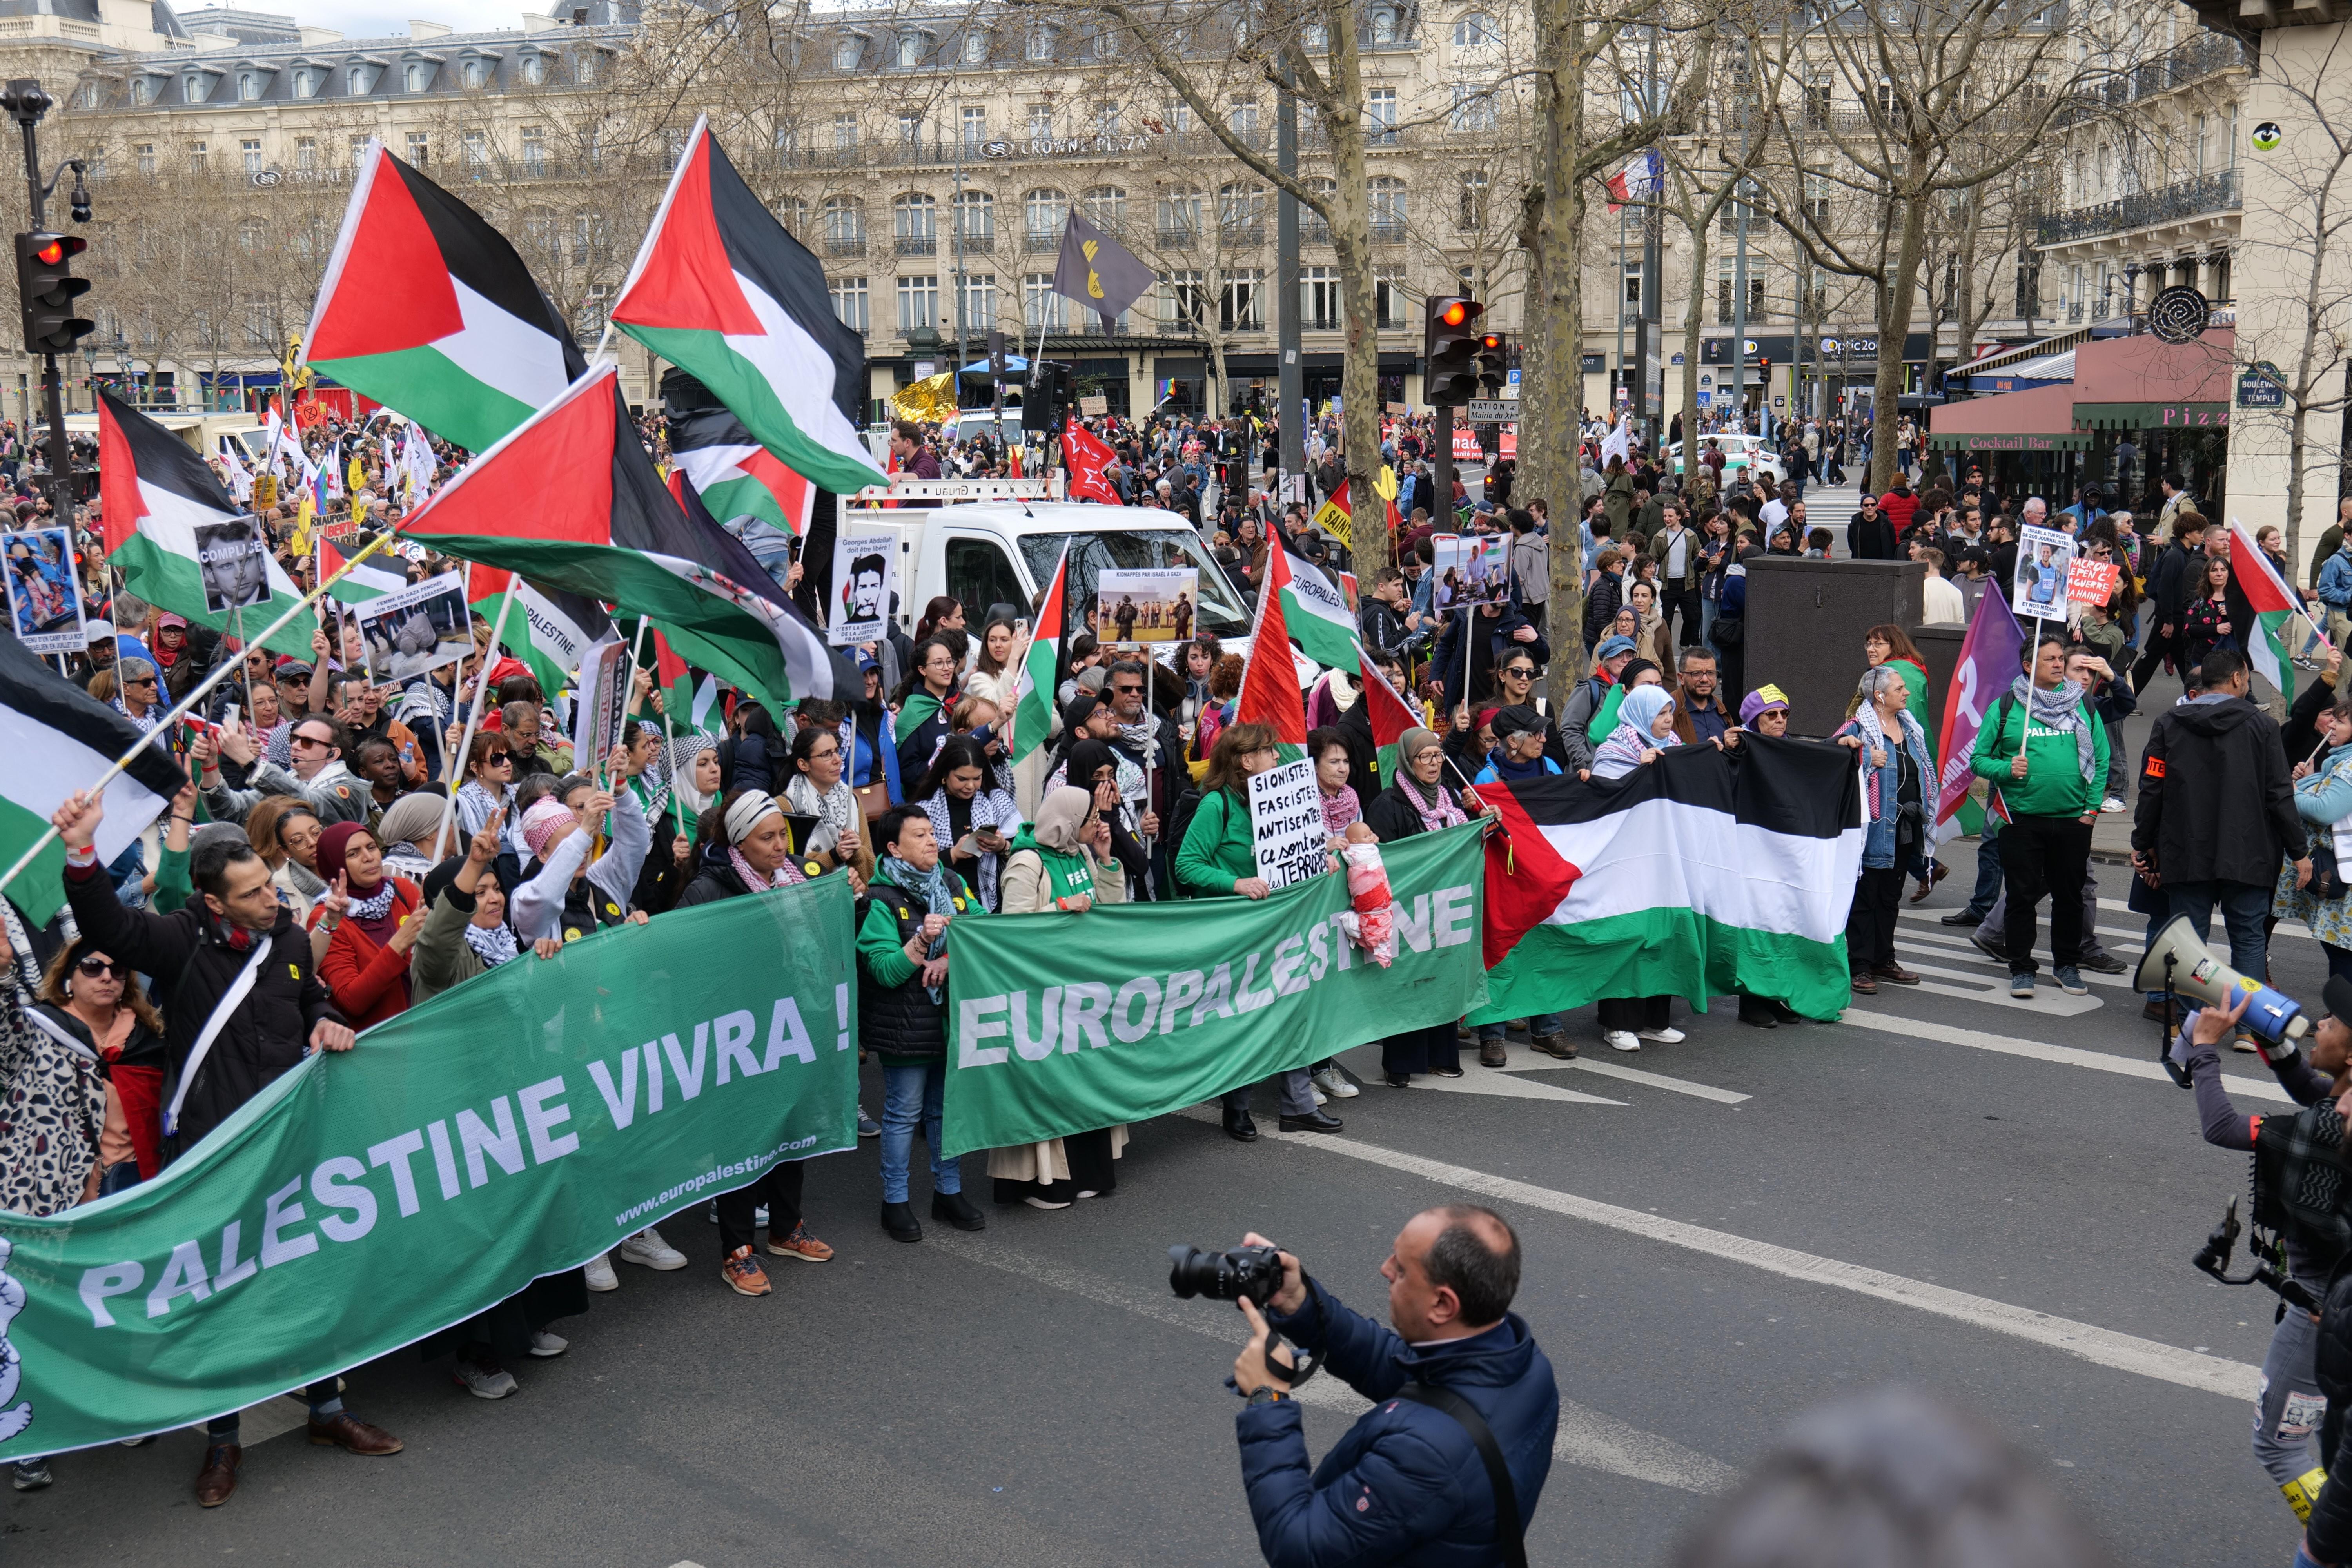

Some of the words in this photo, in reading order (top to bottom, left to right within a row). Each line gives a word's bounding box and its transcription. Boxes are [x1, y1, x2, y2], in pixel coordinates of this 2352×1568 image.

[1021, 138, 1088, 156] CROWNE
[1097, 135, 1149, 153] PLAZA
[1829, 340, 1861, 354] Opic
[1969, 437, 2023, 449] Cocktail
[2028, 437, 2053, 449] Bar
[1324, 510, 1352, 544] SAINT-
[842, 539, 868, 547] Georges
[870, 536, 893, 544] Abdallah
[2038, 535, 2069, 546] JOURNALISTES
[200, 540, 262, 564] COMPLICE
[2070, 557, 2109, 573] MACRON
[2077, 569, 2096, 579] PEN
[376, 597, 396, 607] FEMME
[405, 590, 420, 598] GAZA
[420, 580, 443, 593] PENCHÉE
[399, 596, 420, 606] ENFANT
[421, 585, 448, 599] ASSASSINÉ
[2074, 580, 2110, 592] GUERRE
[2076, 589, 2104, 604] HAINE
[2033, 610, 2053, 618] TAISENT
[2040, 603, 2058, 613] MÉDIAS
[844, 634, 873, 642] FRANÇAISE
[617, 654, 624, 671] DE
[614, 671, 624, 708] GAZA
[598, 662, 611, 751] RÉSISTANCE
[612, 720, 620, 747] PAR
[1278, 831, 1309, 861] sont
[1267, 868, 1281, 890] les
[79, 1075, 580, 1328] PALESTINE
[586, 996, 817, 1131] VIVRA
[835, 982, 849, 1052] !
[615, 1133, 818, 1227] www.europalestine.com
